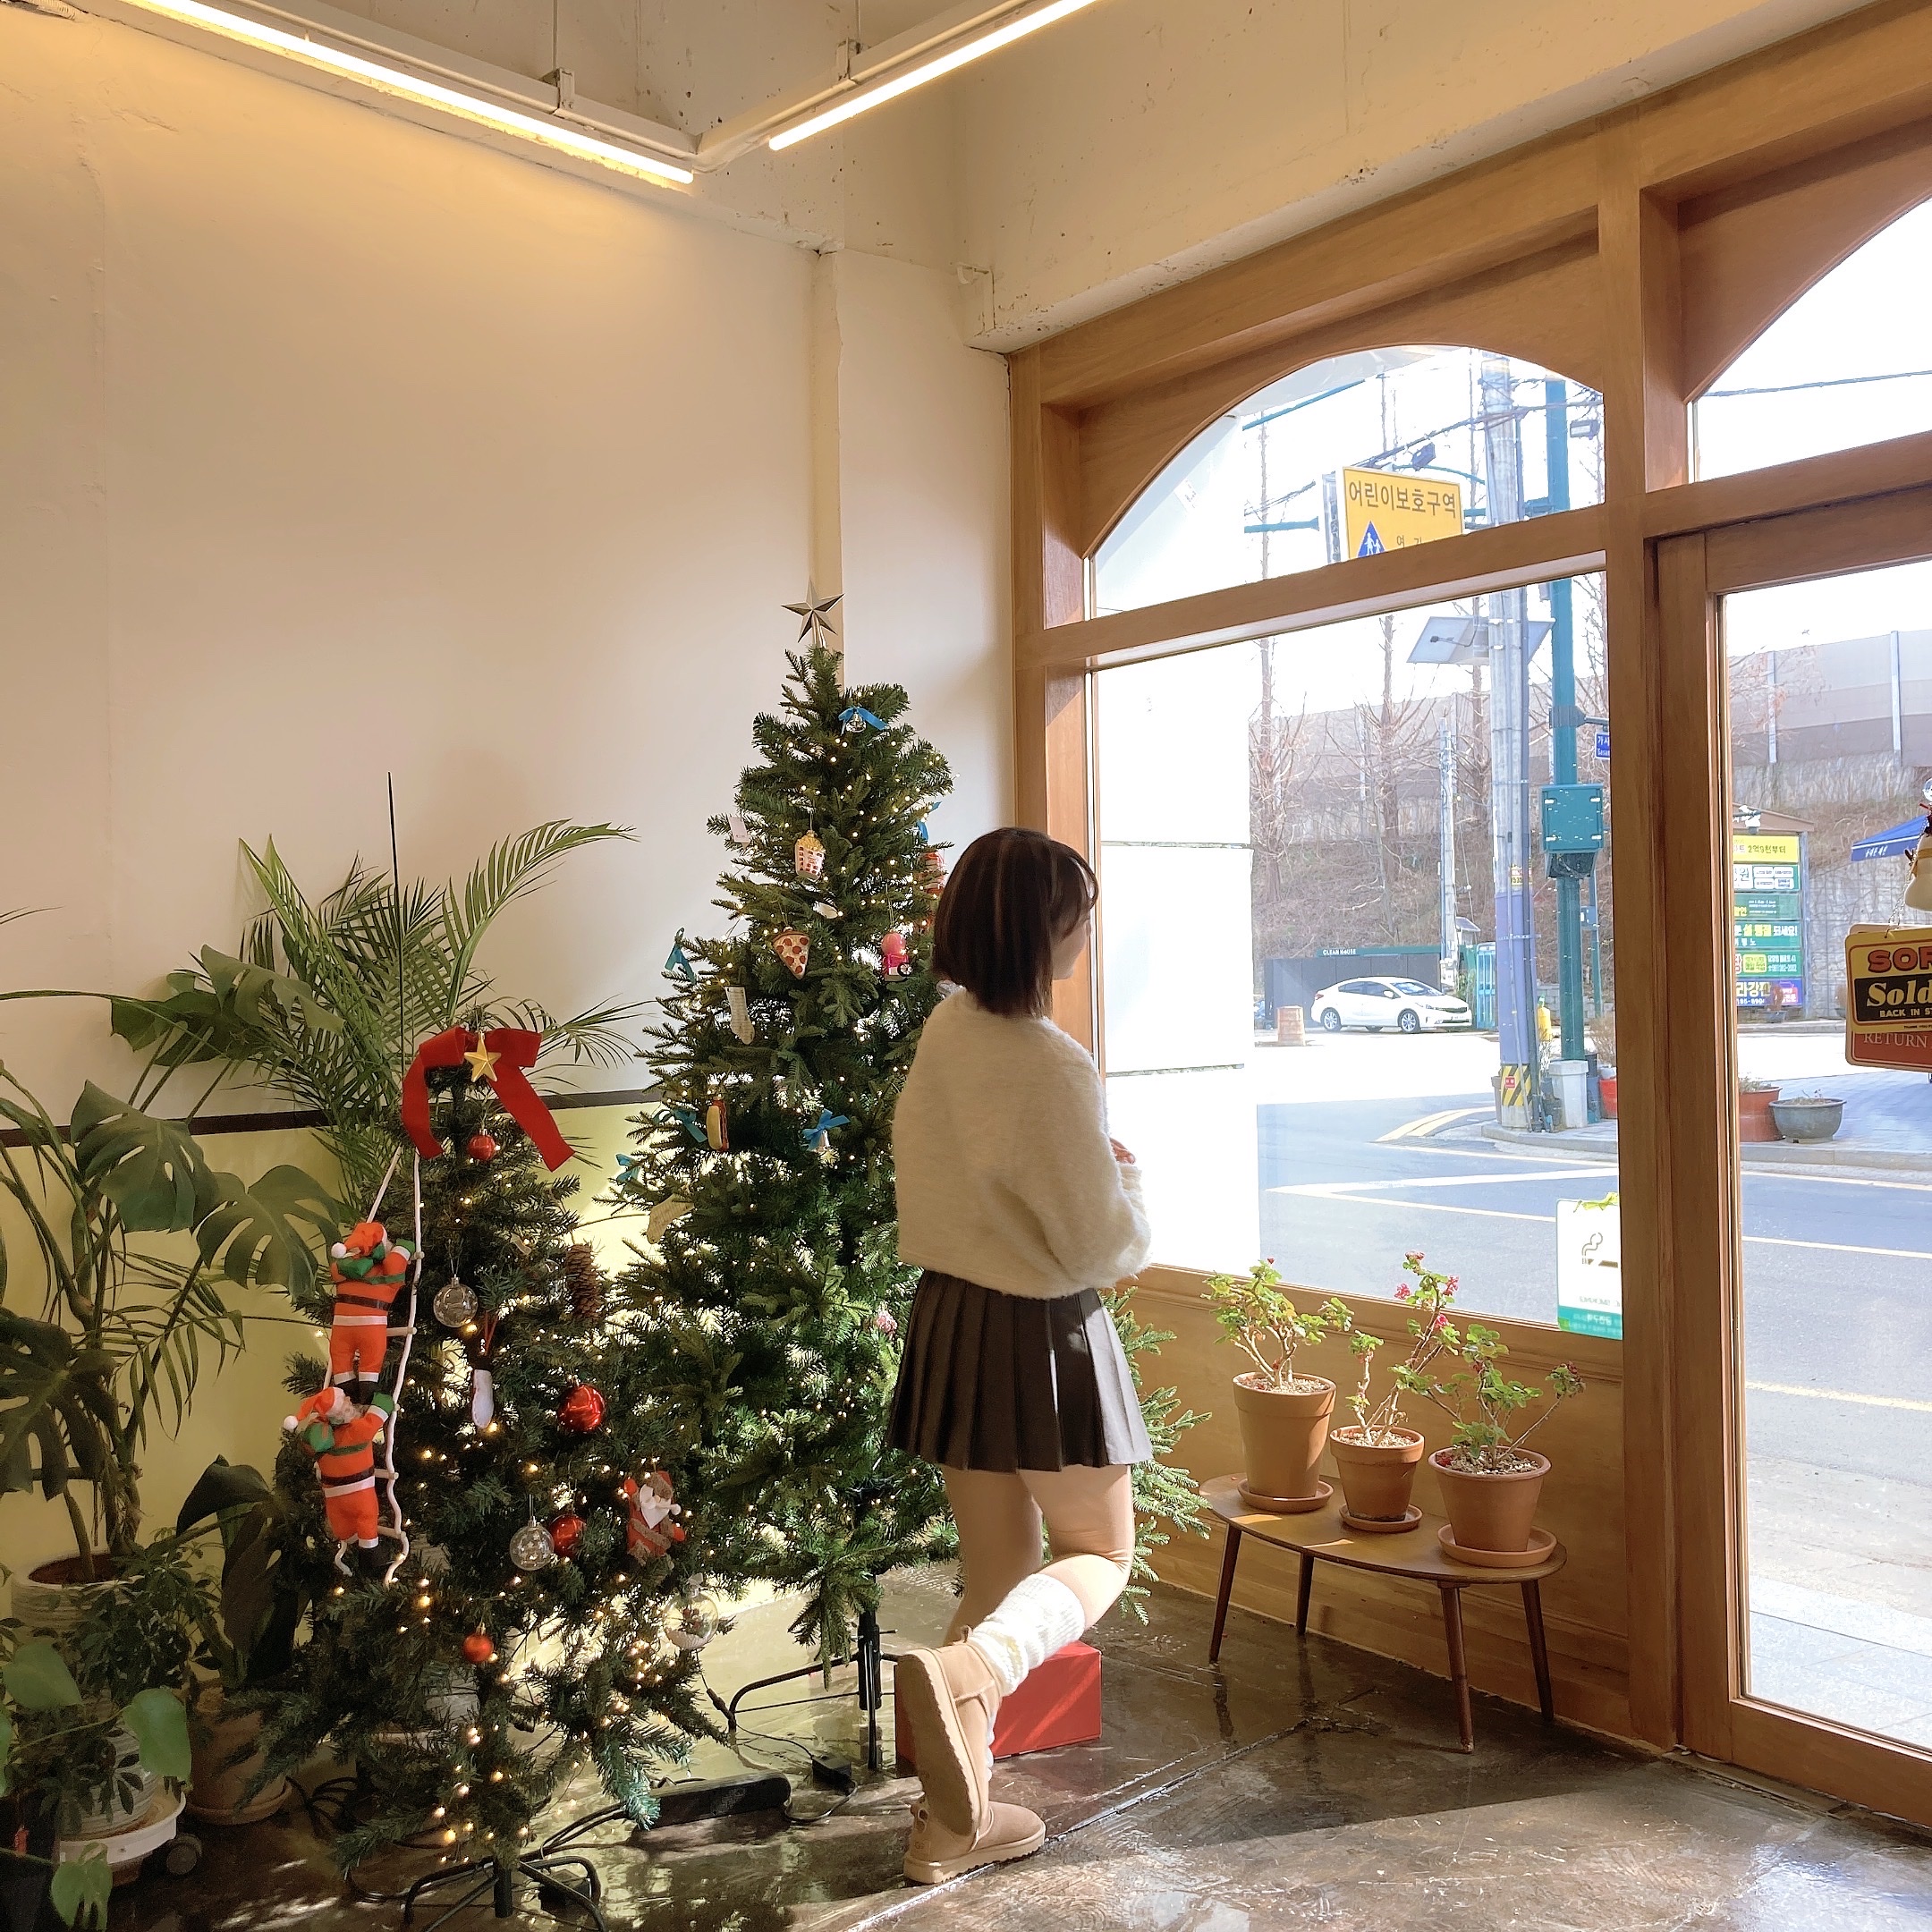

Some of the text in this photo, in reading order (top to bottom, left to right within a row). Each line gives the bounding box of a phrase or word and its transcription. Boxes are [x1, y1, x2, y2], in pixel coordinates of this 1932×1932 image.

[1349, 479, 1456, 519] 어린이보호구역
[1867, 979, 1932, 1007] Sold
[1879, 1008, 1906, 1018] BACK
[1911, 1008, 1920, 1016] IN
[1863, 1032, 1928, 1048] RETURN
